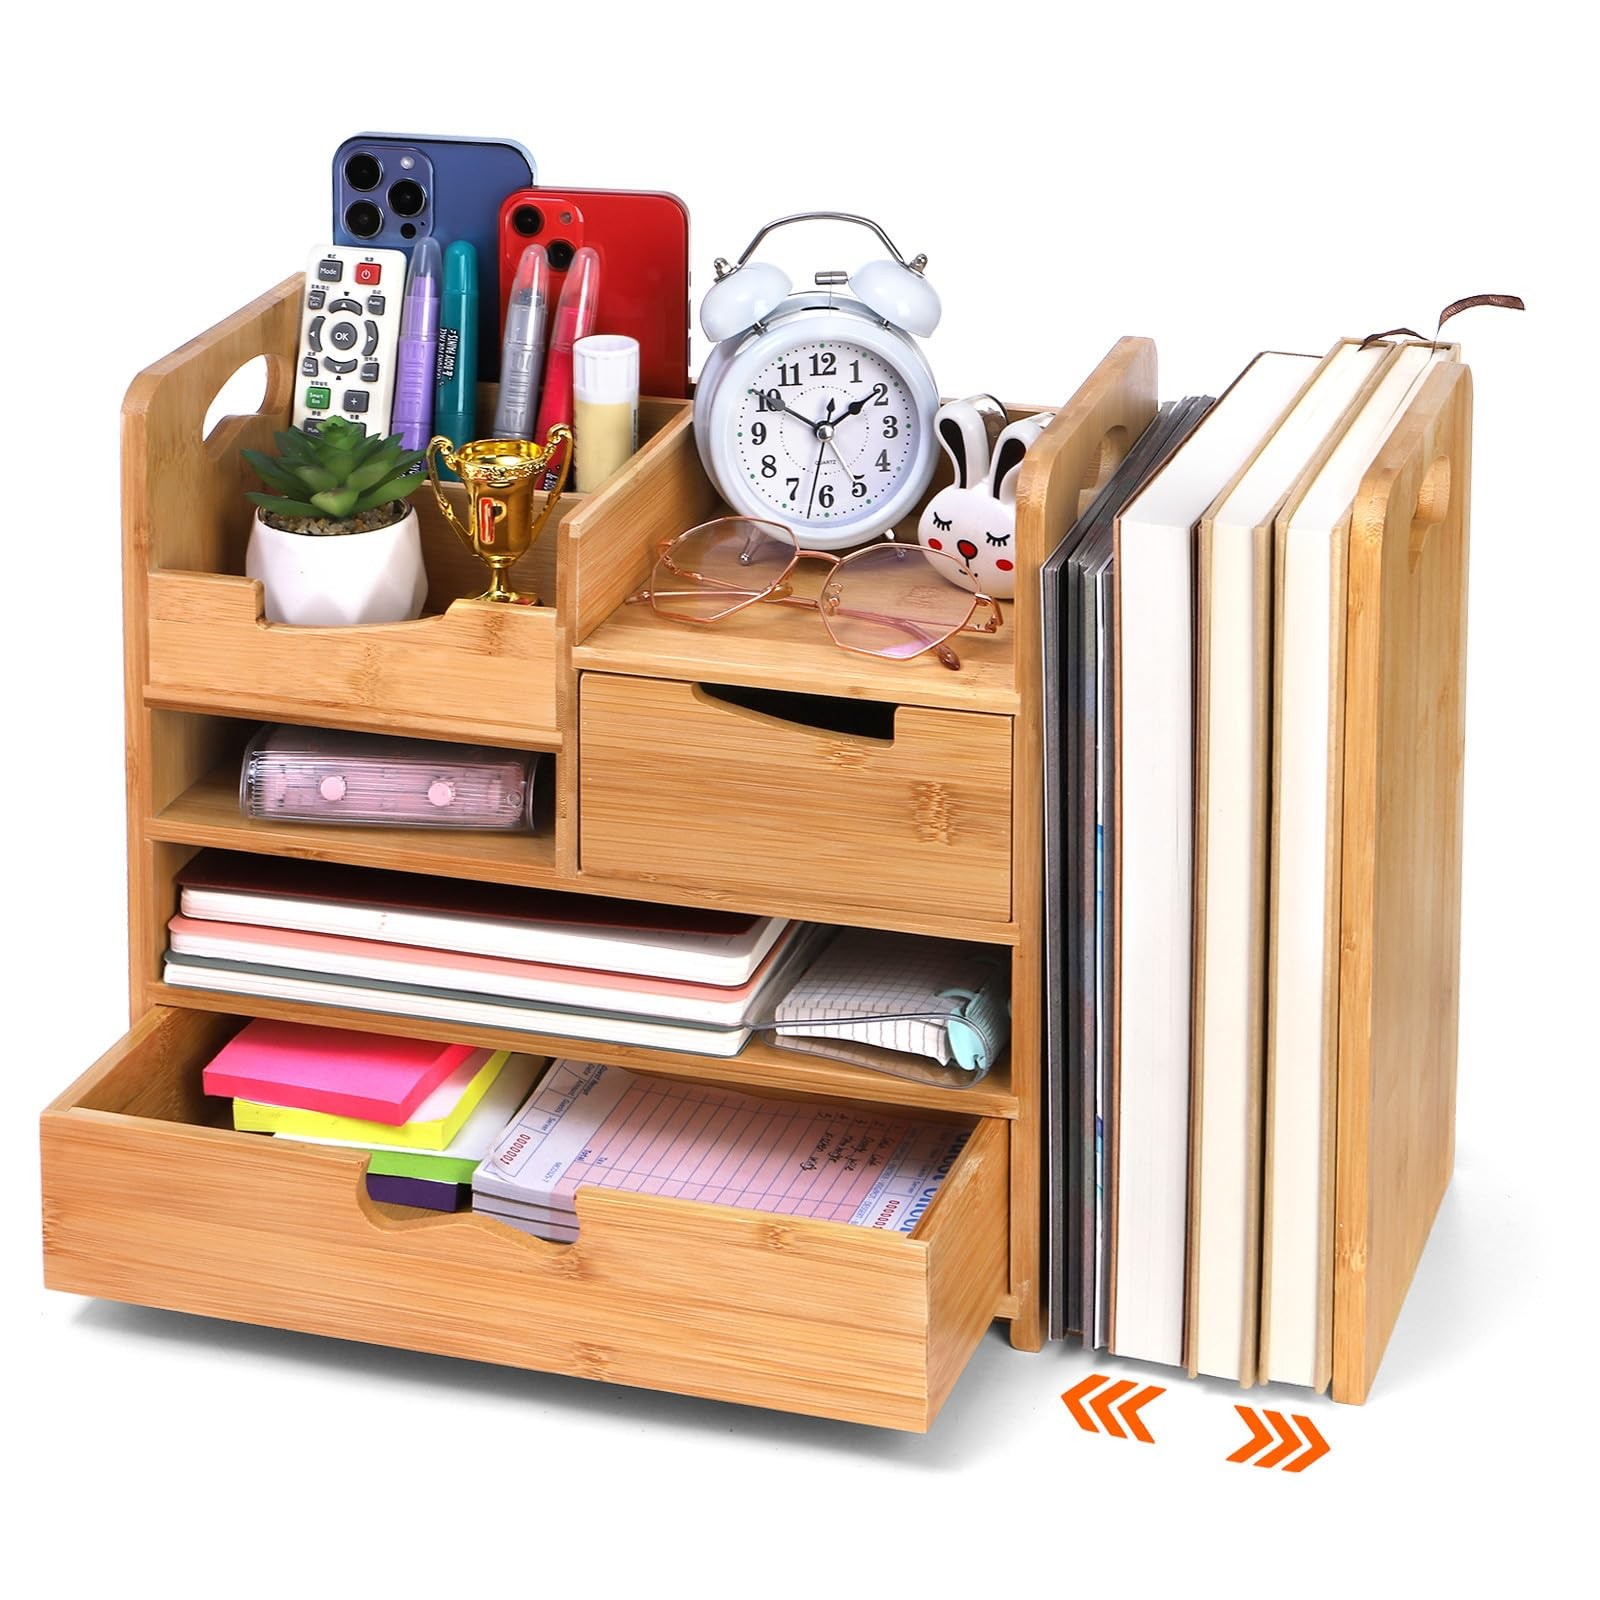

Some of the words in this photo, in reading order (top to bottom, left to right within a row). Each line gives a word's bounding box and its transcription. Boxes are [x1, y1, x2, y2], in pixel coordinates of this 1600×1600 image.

[320, 267, 337, 275] Mode
[335, 331, 349, 342] OK
[443, 354, 456, 370] BODY
[809, 352, 837, 377] 12
[849, 359, 863, 384] 1
[777, 363, 803, 387] 11
[755, 388, 783, 413] 10
[873, 383, 889, 407] 2
[751, 422, 767, 446] 9
[882, 416, 898, 439] 3
[761, 454, 777, 479] 8
[875, 449, 892, 472] 4
[786, 477, 800, 502] 7
[818, 485, 835, 508] 6
[851, 474, 868, 498] 5
[500, 1133, 531, 1165] 0000001
[577, 1149, 593, 1162] Total
